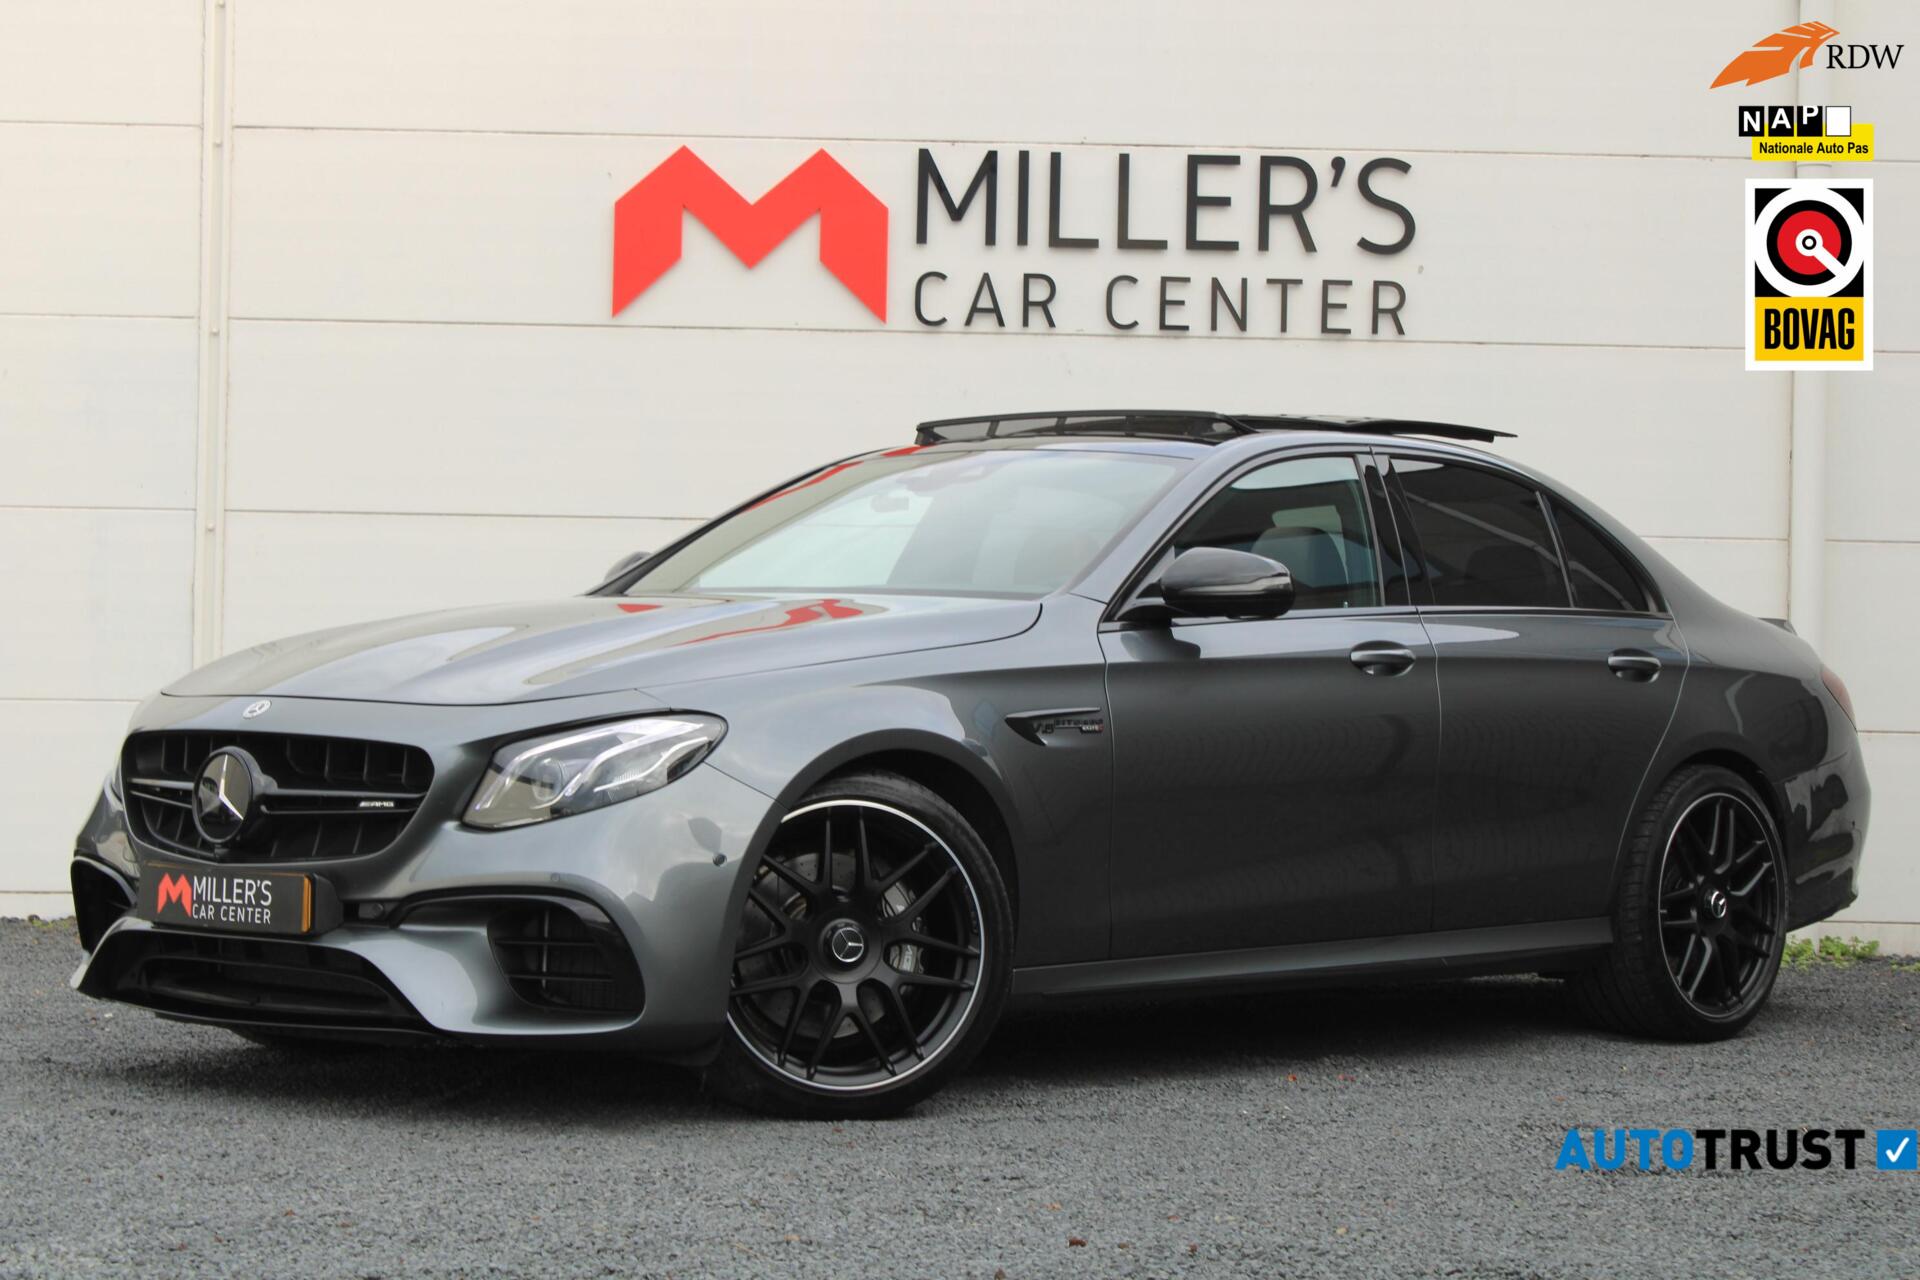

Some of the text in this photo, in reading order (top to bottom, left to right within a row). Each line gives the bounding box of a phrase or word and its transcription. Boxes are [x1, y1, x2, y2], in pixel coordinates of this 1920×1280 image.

[916, 148, 1416, 255] MILLER'S
[914, 271, 1406, 336] CAR CENTER
[192, 903, 271, 925] CAR CENTER
[193, 875, 272, 906] MILLER'S
